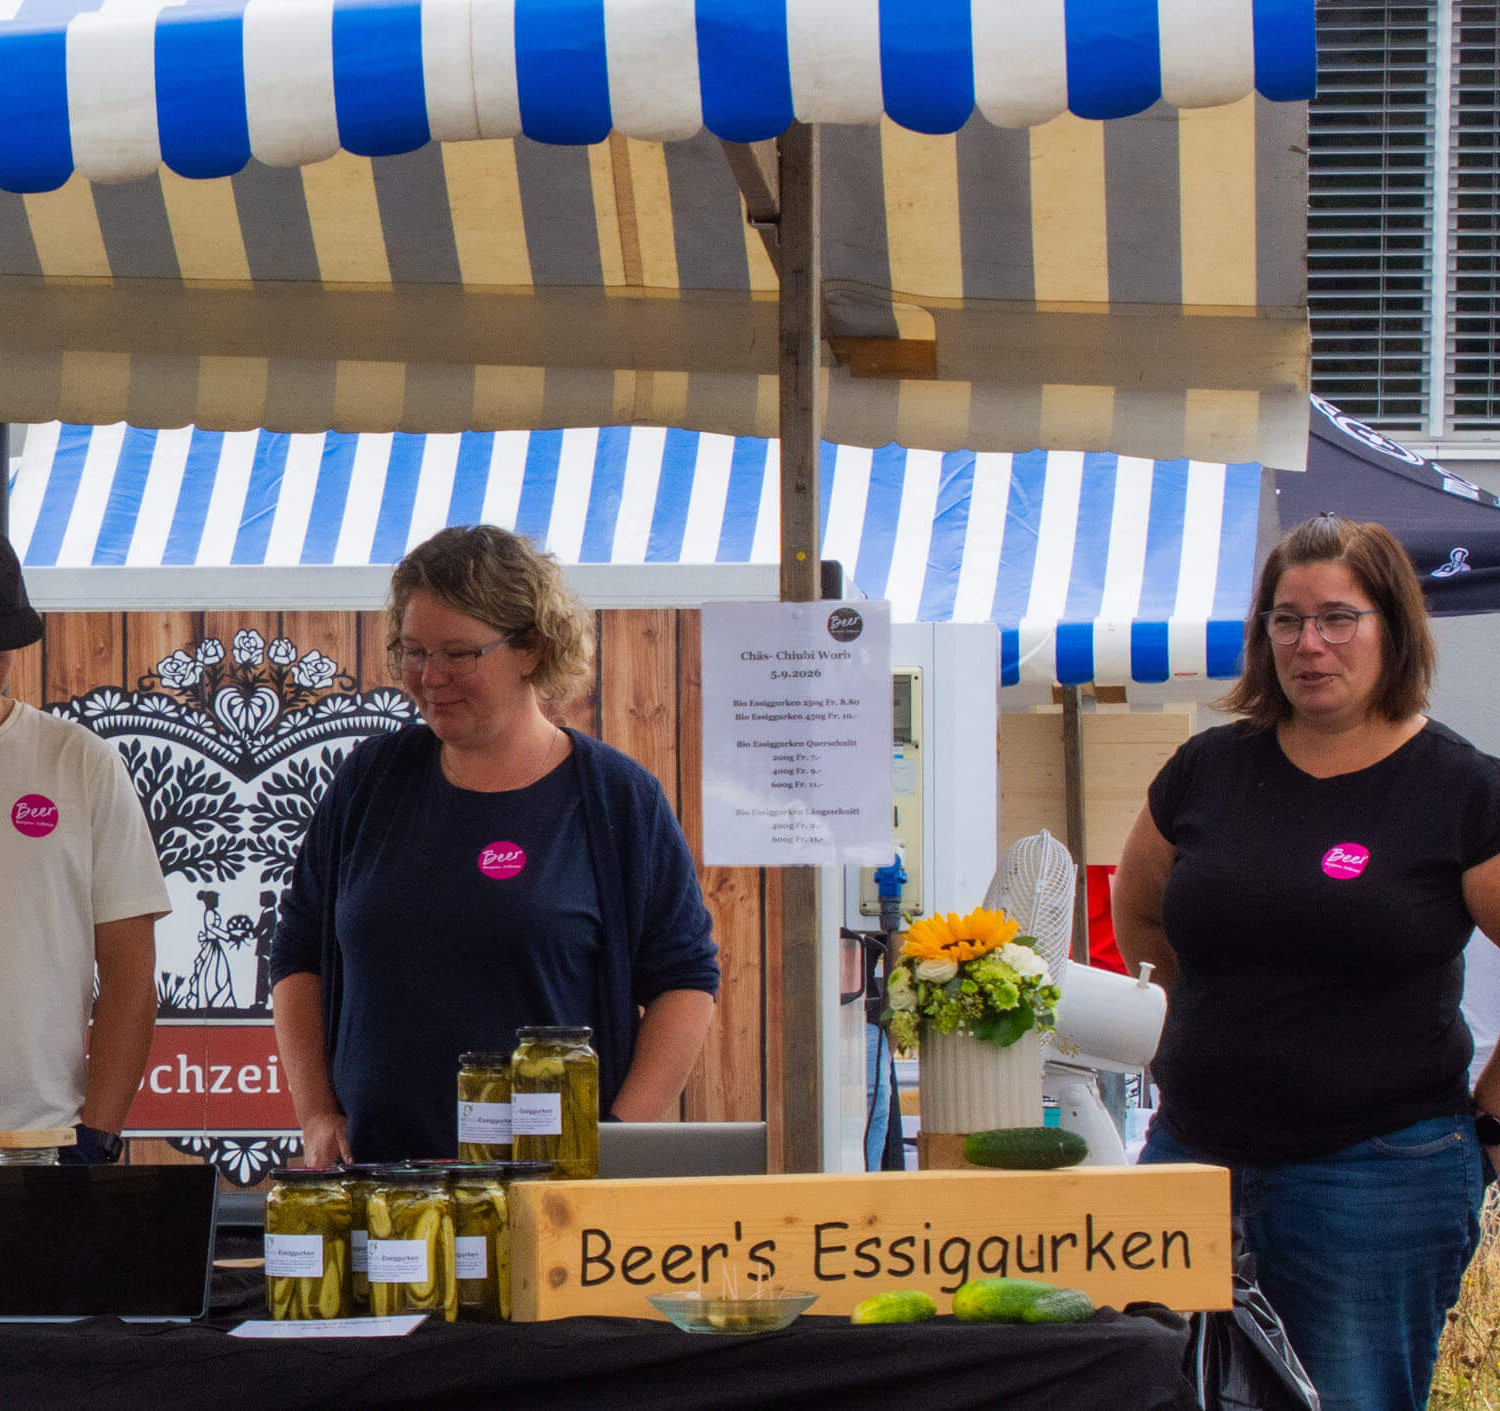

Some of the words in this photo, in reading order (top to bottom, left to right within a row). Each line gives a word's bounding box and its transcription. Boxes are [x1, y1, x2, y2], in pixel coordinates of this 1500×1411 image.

[830, 615, 861, 629] Beer
[776, 650, 815, 660] Chiubi
[818, 650, 851, 660] Worb
[770, 668, 822, 680] 5.9.2026
[733, 699, 747, 707] Bio
[750, 699, 800, 708] Essiggurken
[735, 713, 749, 721] Bio
[751, 713, 803, 722] Essiggurken
[736, 740, 751, 748] Bio
[753, 740, 804, 749] Essiggurken
[806, 739, 857, 748] Querschnitt
[15, 802, 57, 820] Beer
[482, 850, 523, 866] Beer
[1327, 848, 1369, 864] Beer
[138, 1054, 293, 1093] chzei
[580, 1221, 777, 1287] Beer's
[813, 1214, 1192, 1295] Essiggurken
